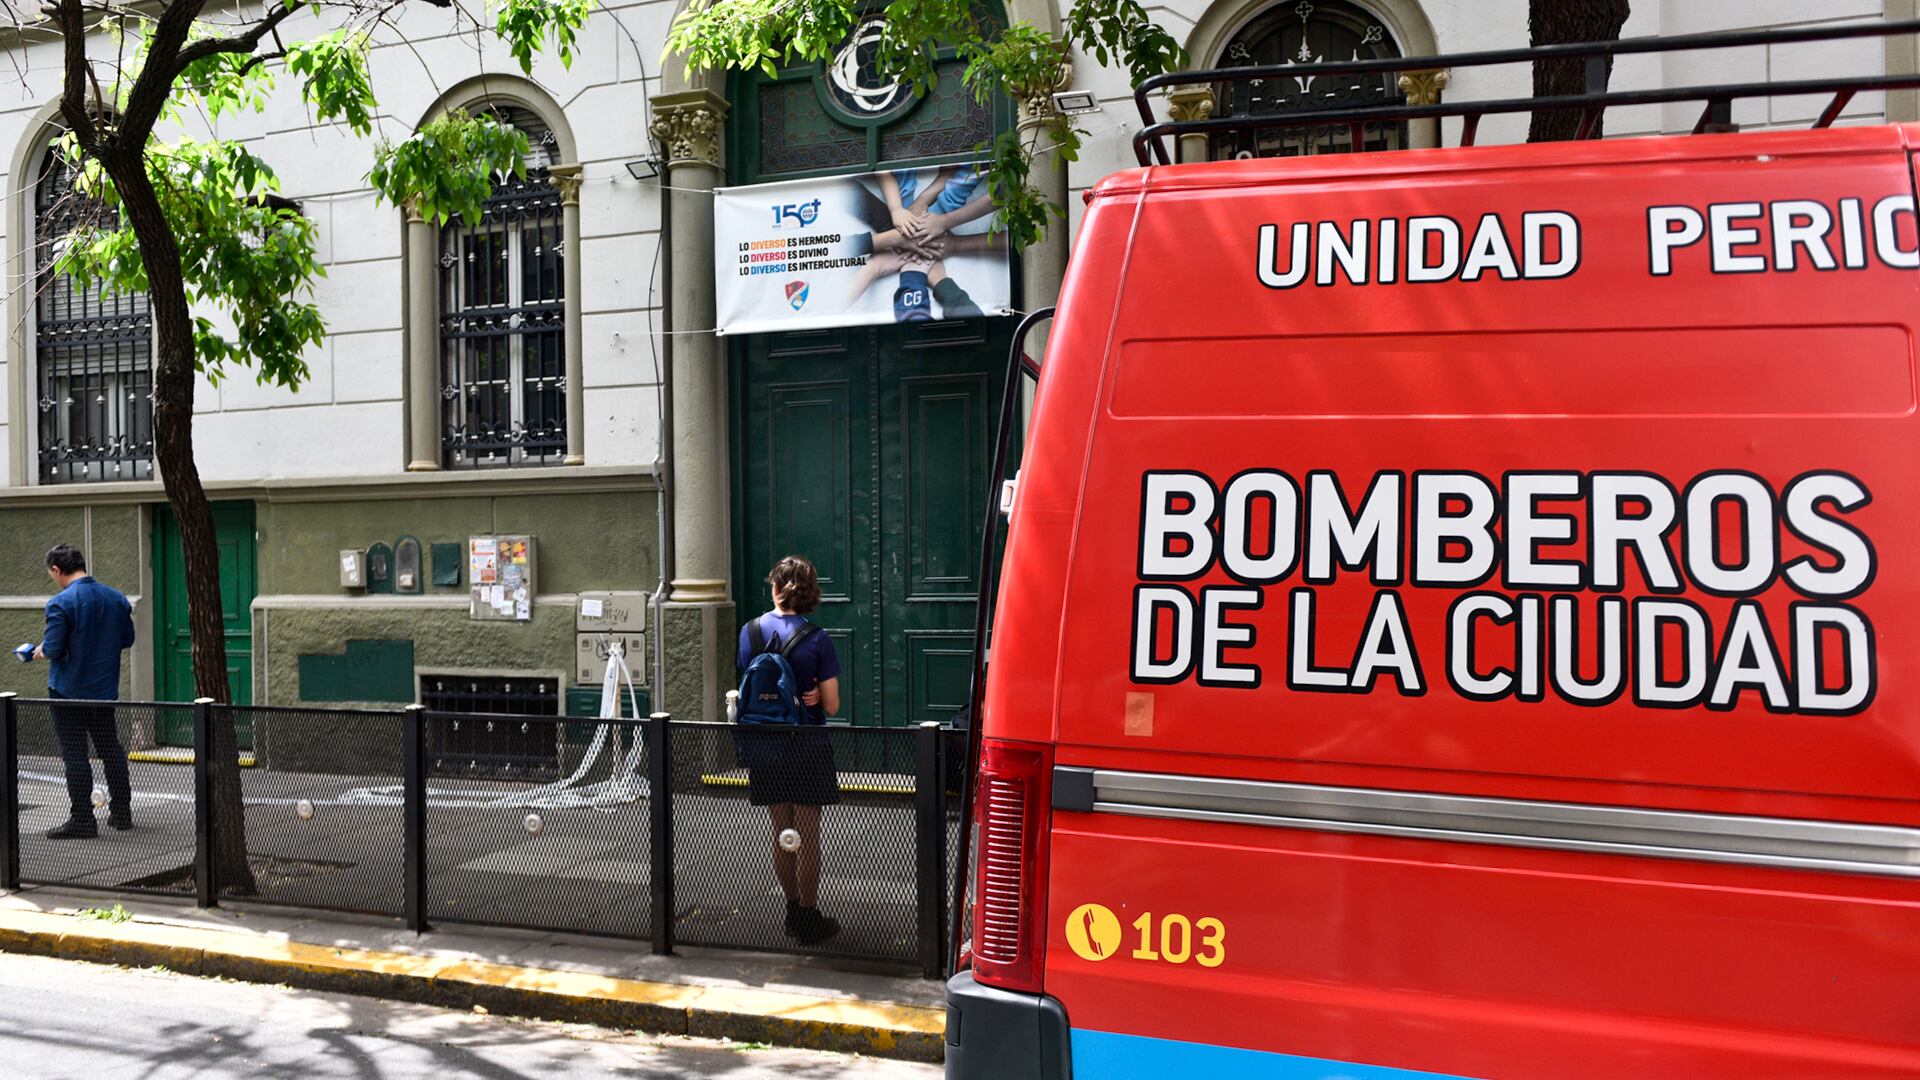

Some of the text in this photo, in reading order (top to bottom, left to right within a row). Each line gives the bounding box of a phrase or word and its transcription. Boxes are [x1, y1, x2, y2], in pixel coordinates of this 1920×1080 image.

[739, 234, 841, 252] LO DIVERSO ES HERMOSO
[739, 247, 829, 263] LO DIVERSO ES DIVINO
[1257, 210, 1580, 289] UNIDAD
[739, 257, 867, 275] LO DIVERSO ES INTERCULTURAL
[904, 290, 923, 307] CG
[1137, 468, 1878, 597] BOMBEROS
[1131, 584, 1877, 715] DE LA CIUDAD
[1132, 911, 1225, 968] 103
